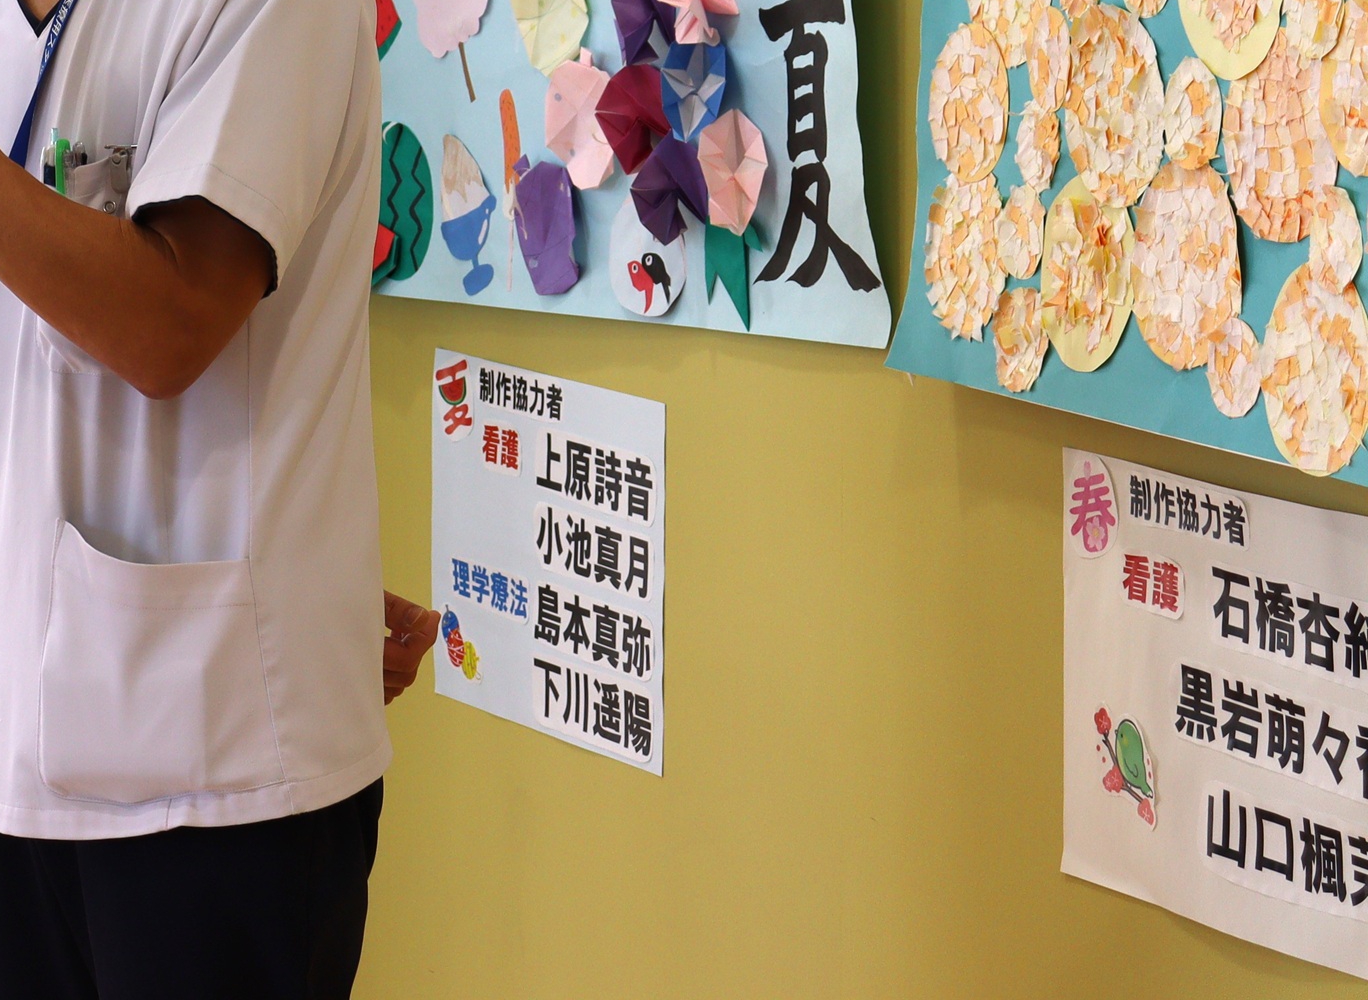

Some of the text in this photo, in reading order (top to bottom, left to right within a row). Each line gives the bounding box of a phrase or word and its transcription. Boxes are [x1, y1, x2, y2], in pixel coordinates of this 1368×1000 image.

[479, 367, 563, 421] 制作協力者
[482, 425, 519, 470] 看護
[536, 432, 653, 521] 上原詩音
[1069, 461, 1117, 553] 春
[1129, 475, 1246, 547] 制作協力者
[451, 557, 528, 619] 理学療法
[536, 506, 650, 599] 小池真月
[1122, 553, 1179, 613] 看護
[534, 584, 651, 678] 島本真弥
[533, 658, 652, 756] 下川遥陽
